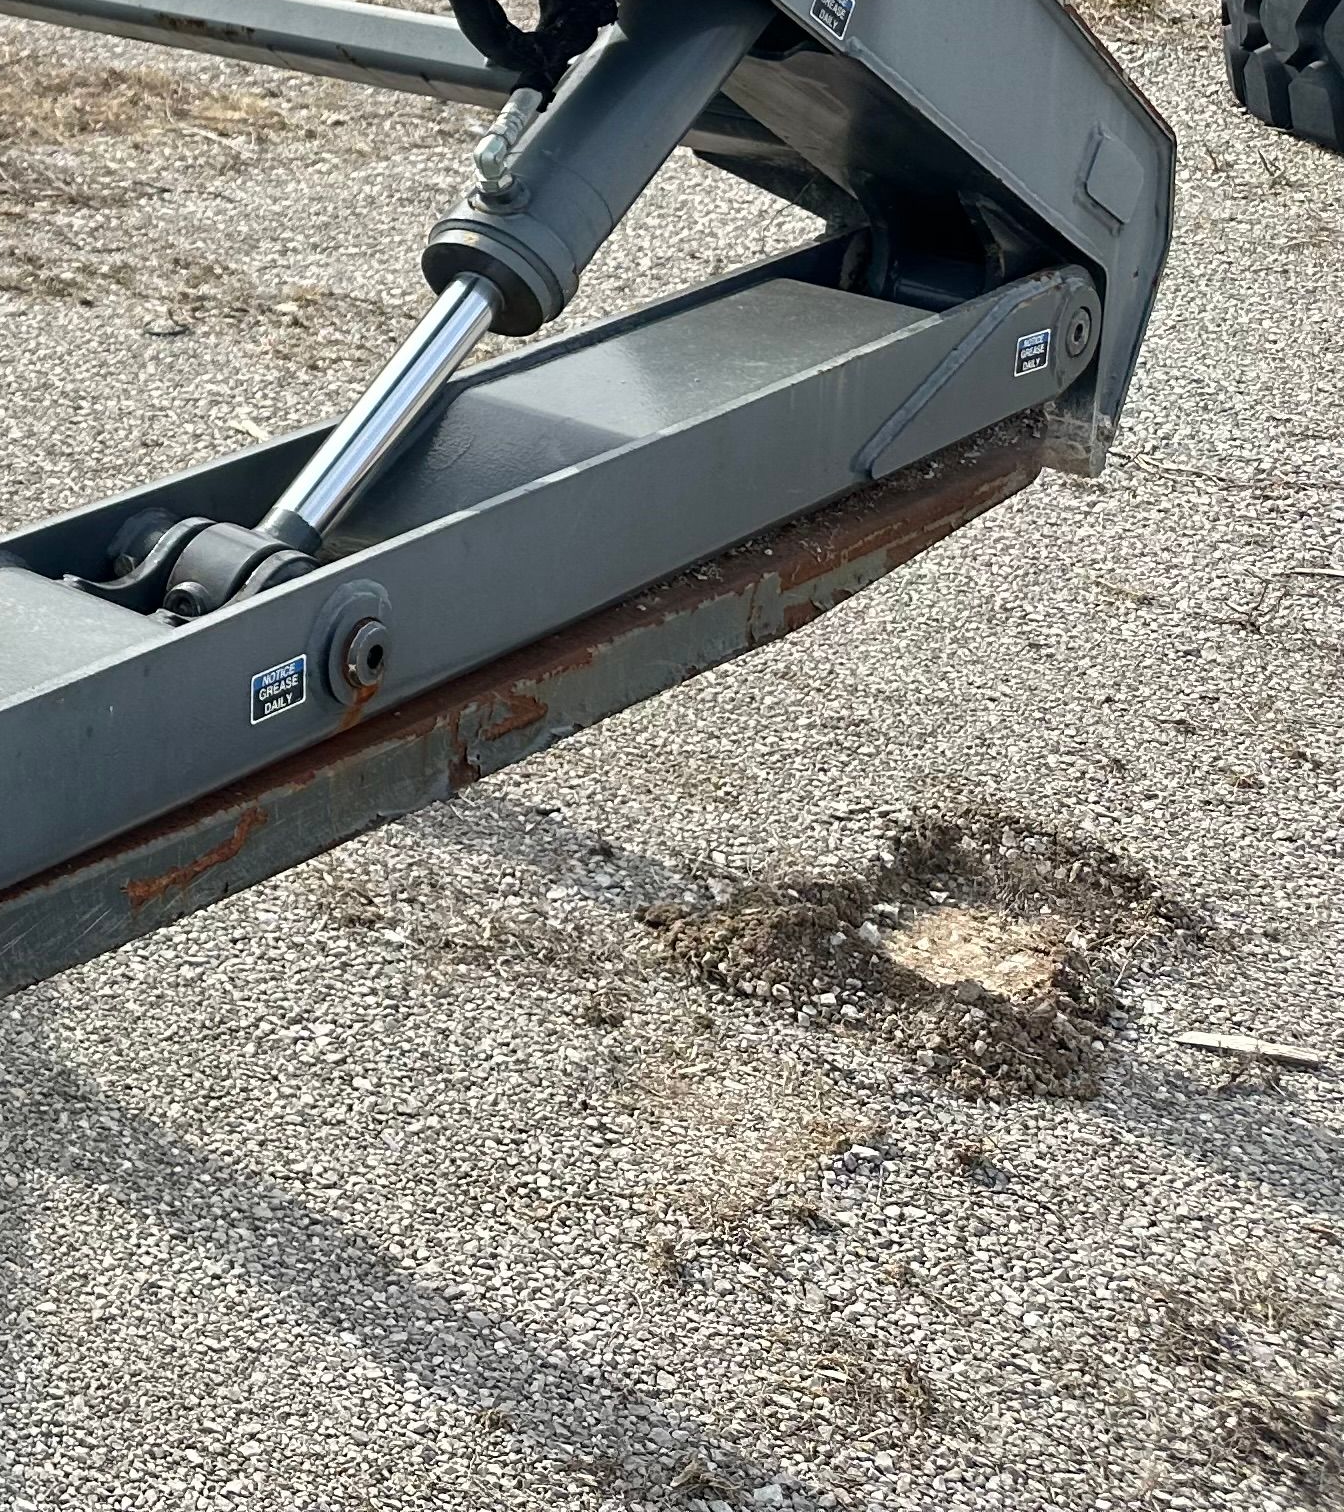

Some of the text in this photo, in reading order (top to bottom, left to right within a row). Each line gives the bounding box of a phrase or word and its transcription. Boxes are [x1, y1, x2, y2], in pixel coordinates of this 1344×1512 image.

[261, 662, 296, 687] NOTICE
[258, 674, 299, 701] GREASE
[264, 692, 293, 715] DAILY
